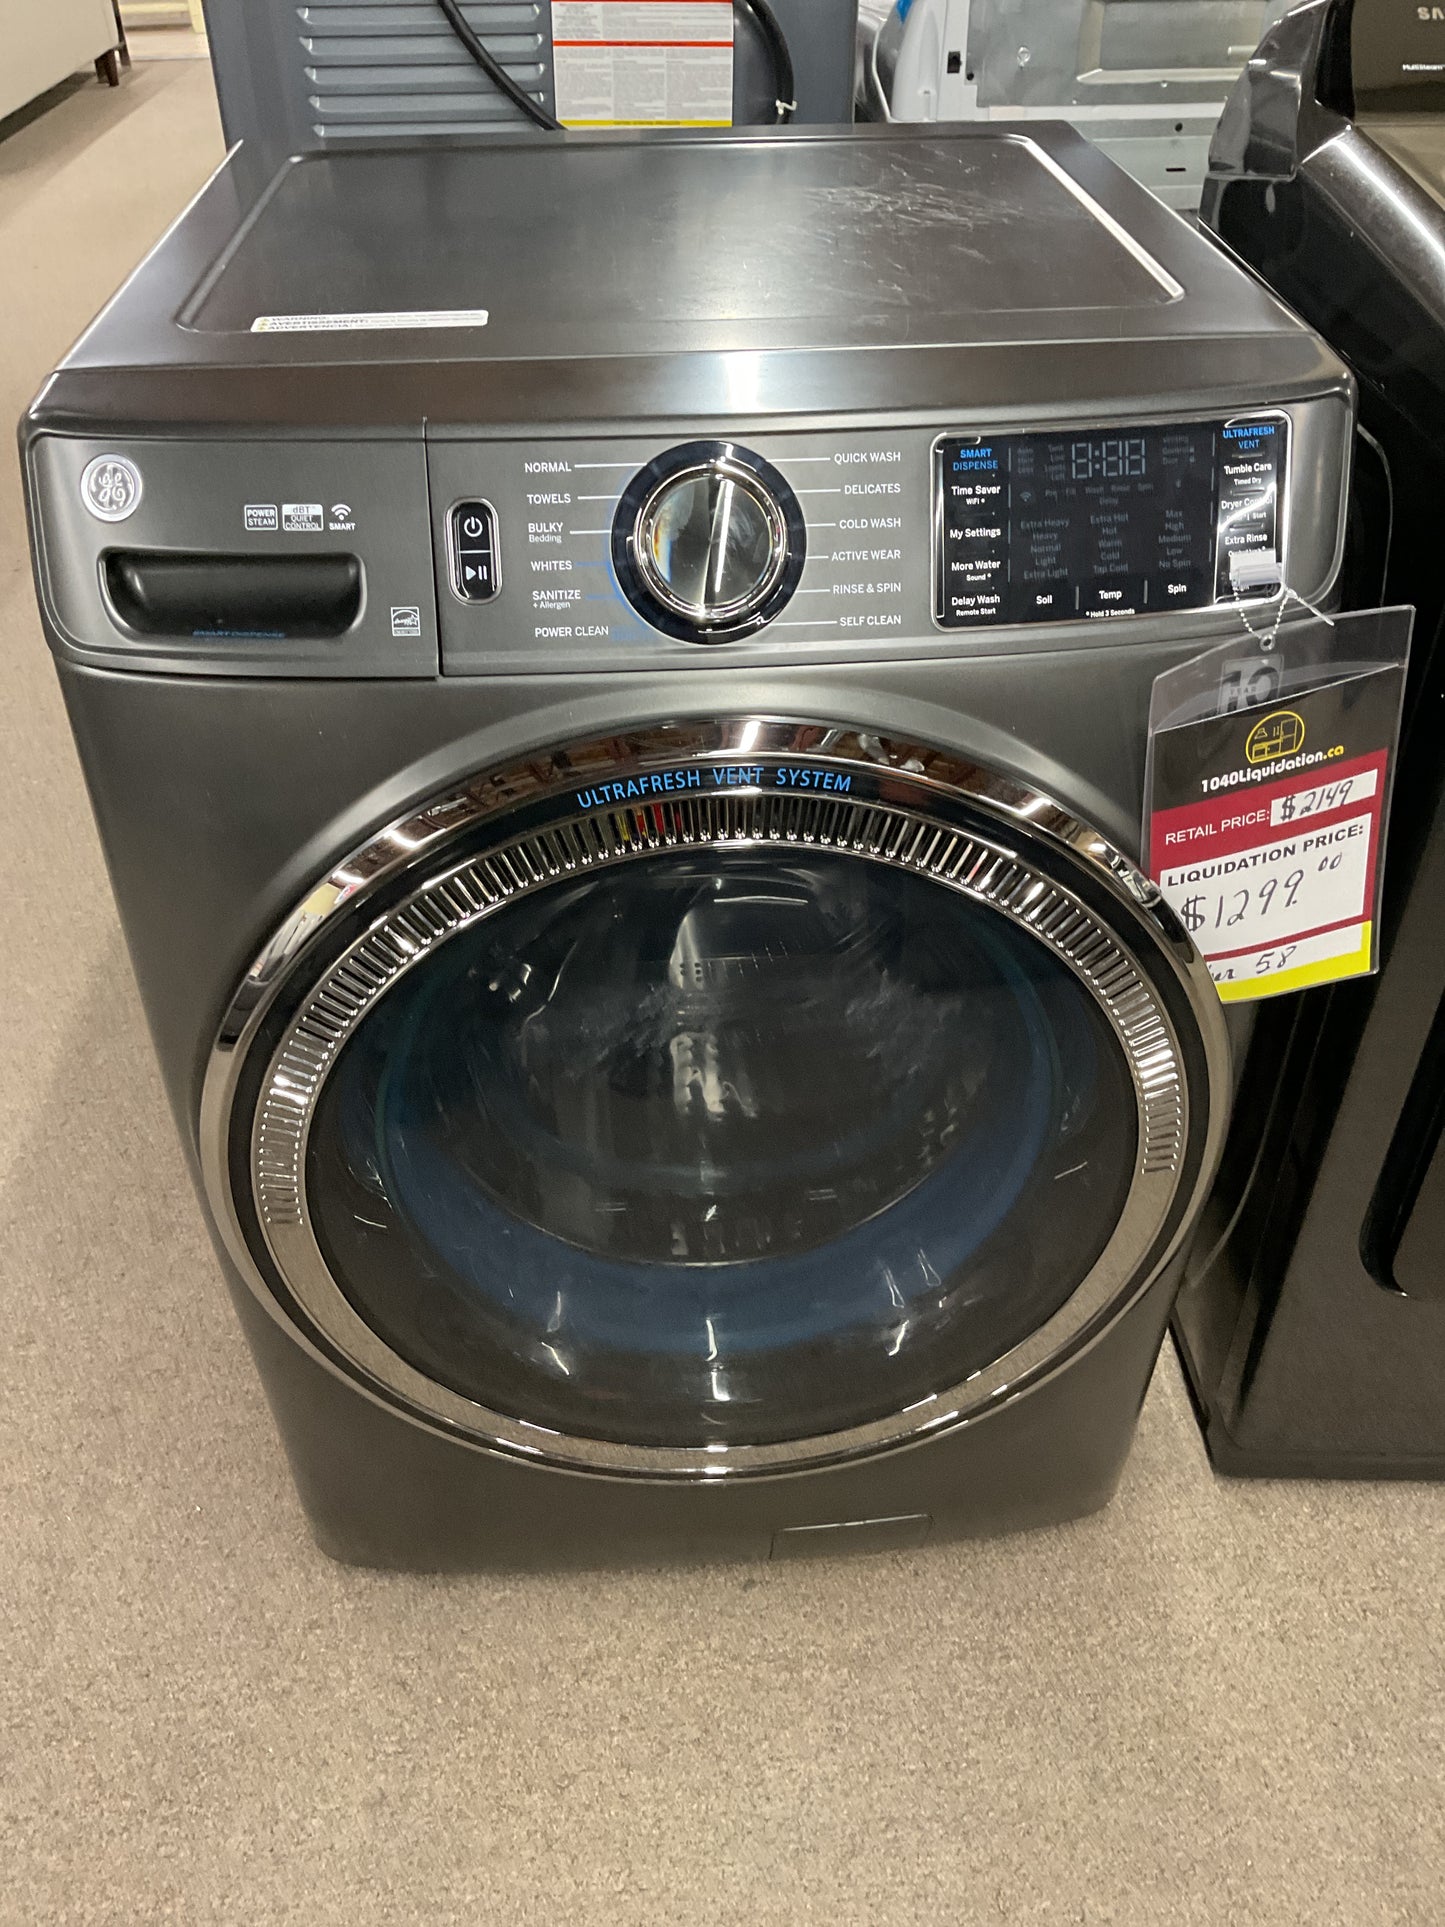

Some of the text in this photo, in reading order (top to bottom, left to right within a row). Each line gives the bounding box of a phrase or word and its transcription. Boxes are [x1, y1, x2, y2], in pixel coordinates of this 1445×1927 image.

[1222, 426, 1275, 439] ULTRAFRESH
[1238, 439, 1260, 449] VENT
[834, 452, 901, 465] QUICK WASH
[960, 448, 992, 459] SMART
[524, 462, 572, 473] NORMAL
[953, 460, 998, 471] DISPENSE
[1224, 462, 1272, 475] Tumble Care
[1252, 476, 1262, 485] Dry
[844, 484, 901, 495] DELICATES
[951, 484, 1001, 496] Time Saver
[526, 494, 572, 504] TOWELS
[1221, 500, 1242, 510] Dryer
[246, 509, 276, 518] POWER
[290, 514, 314, 522] QUIET
[248, 518, 275, 526] STEAM
[285, 522, 320, 530] CONTROL
[329, 523, 356, 531] SMART
[839, 518, 902, 530] COLD WASH
[528, 522, 564, 534] BULKY
[950, 526, 1001, 540] My Settings
[528, 534, 562, 544] Bedding
[1158, 535, 1192, 544] Medium
[1224, 533, 1268, 546] Extra Rinse
[832, 550, 901, 562] ACTIVE WEAR
[530, 560, 573, 572] WHITES
[951, 560, 1001, 571] More Water
[966, 574, 986, 582] Sound
[833, 582, 902, 594] RINSE & SPIN
[1167, 584, 1187, 595] Spin
[532, 590, 582, 601] SANITIZE
[951, 594, 1000, 607] Delay Wash
[1036, 594, 1053, 605] Soil
[1098, 590, 1122, 600] Temp
[540, 601, 570, 610] Allergen
[956, 609, 980, 617] Remote
[1090, 610, 1104, 618] Hold
[1110, 608, 1136, 617] Seconds
[840, 615, 902, 627] SELF CLEAN
[535, 626, 609, 638] POWER CLEAN
[1201, 745, 1344, 793] 1040Liquidation.ca
[576, 767, 852, 809] ULTRAFRESH VENT SYSTEM
[1165, 824, 1218, 846] RETAIL
[1220, 810, 1270, 832] PRICE:
[1167, 824, 1364, 887] LIQUIDATION PRICE:
